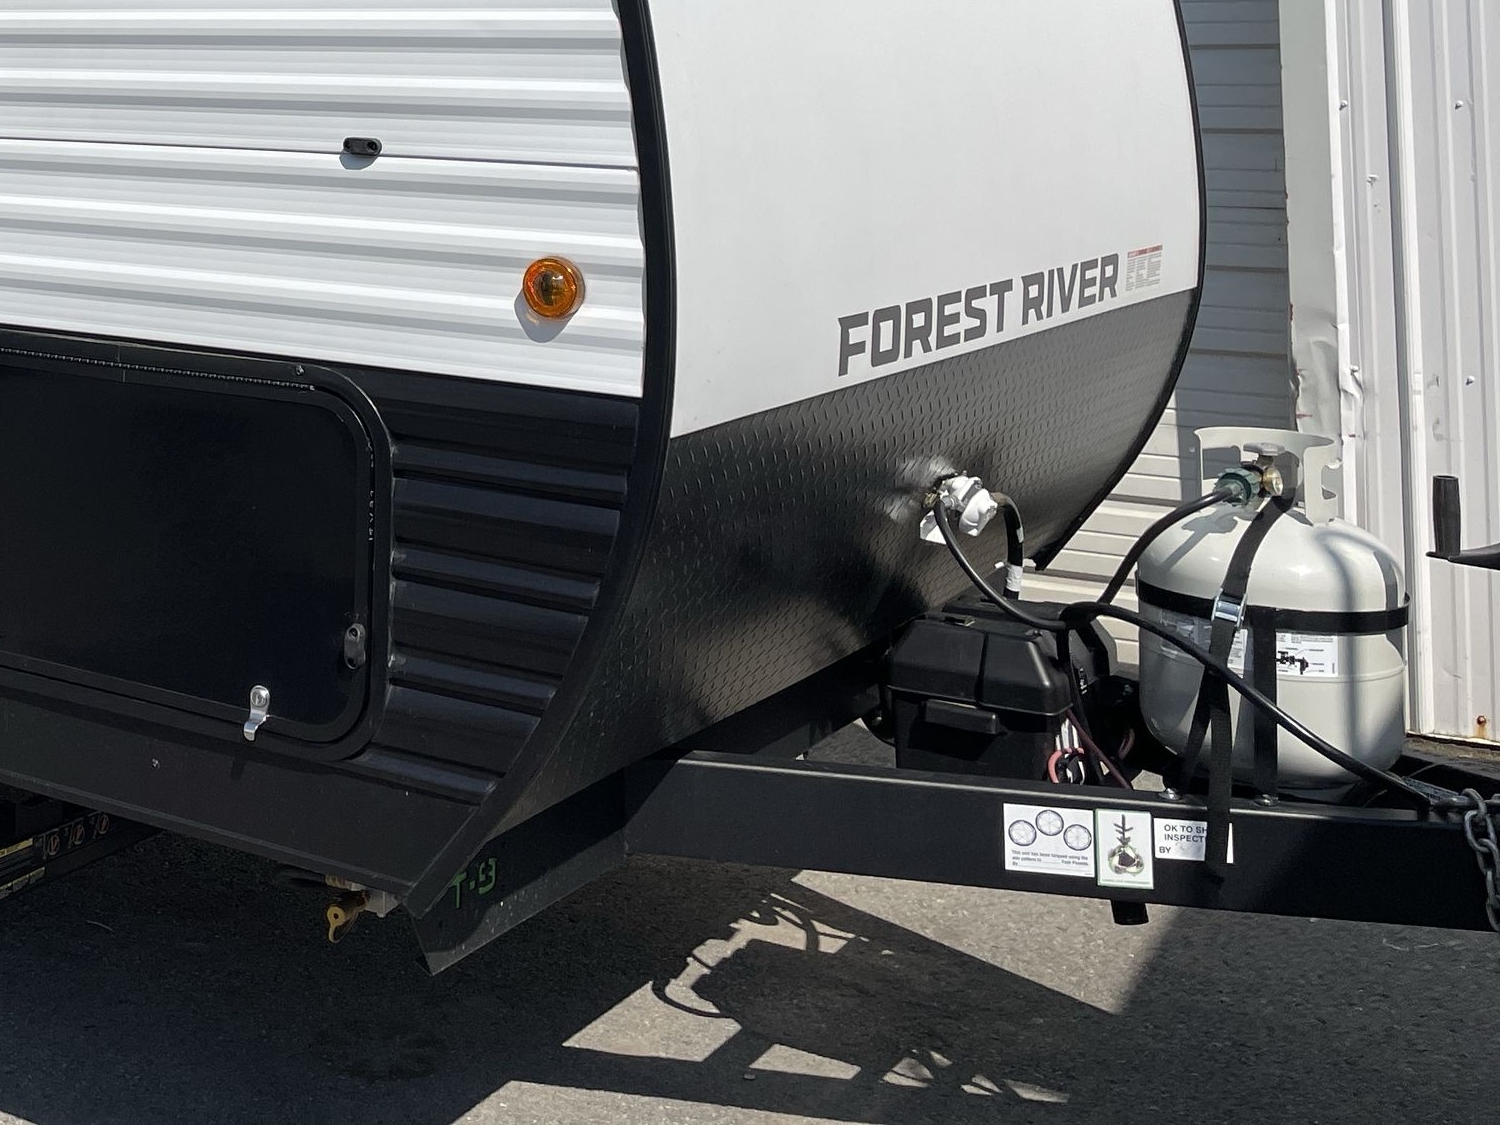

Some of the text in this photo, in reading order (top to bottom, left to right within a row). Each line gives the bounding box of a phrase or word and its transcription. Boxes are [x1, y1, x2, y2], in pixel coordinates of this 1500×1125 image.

[837, 278, 1014, 377] FOREST
[1020, 253, 1120, 326] RIVER
[1164, 824, 1208, 834] OK TO SH
[1164, 834, 1206, 843] INSPECT
[1159, 846, 1171, 854] BY
